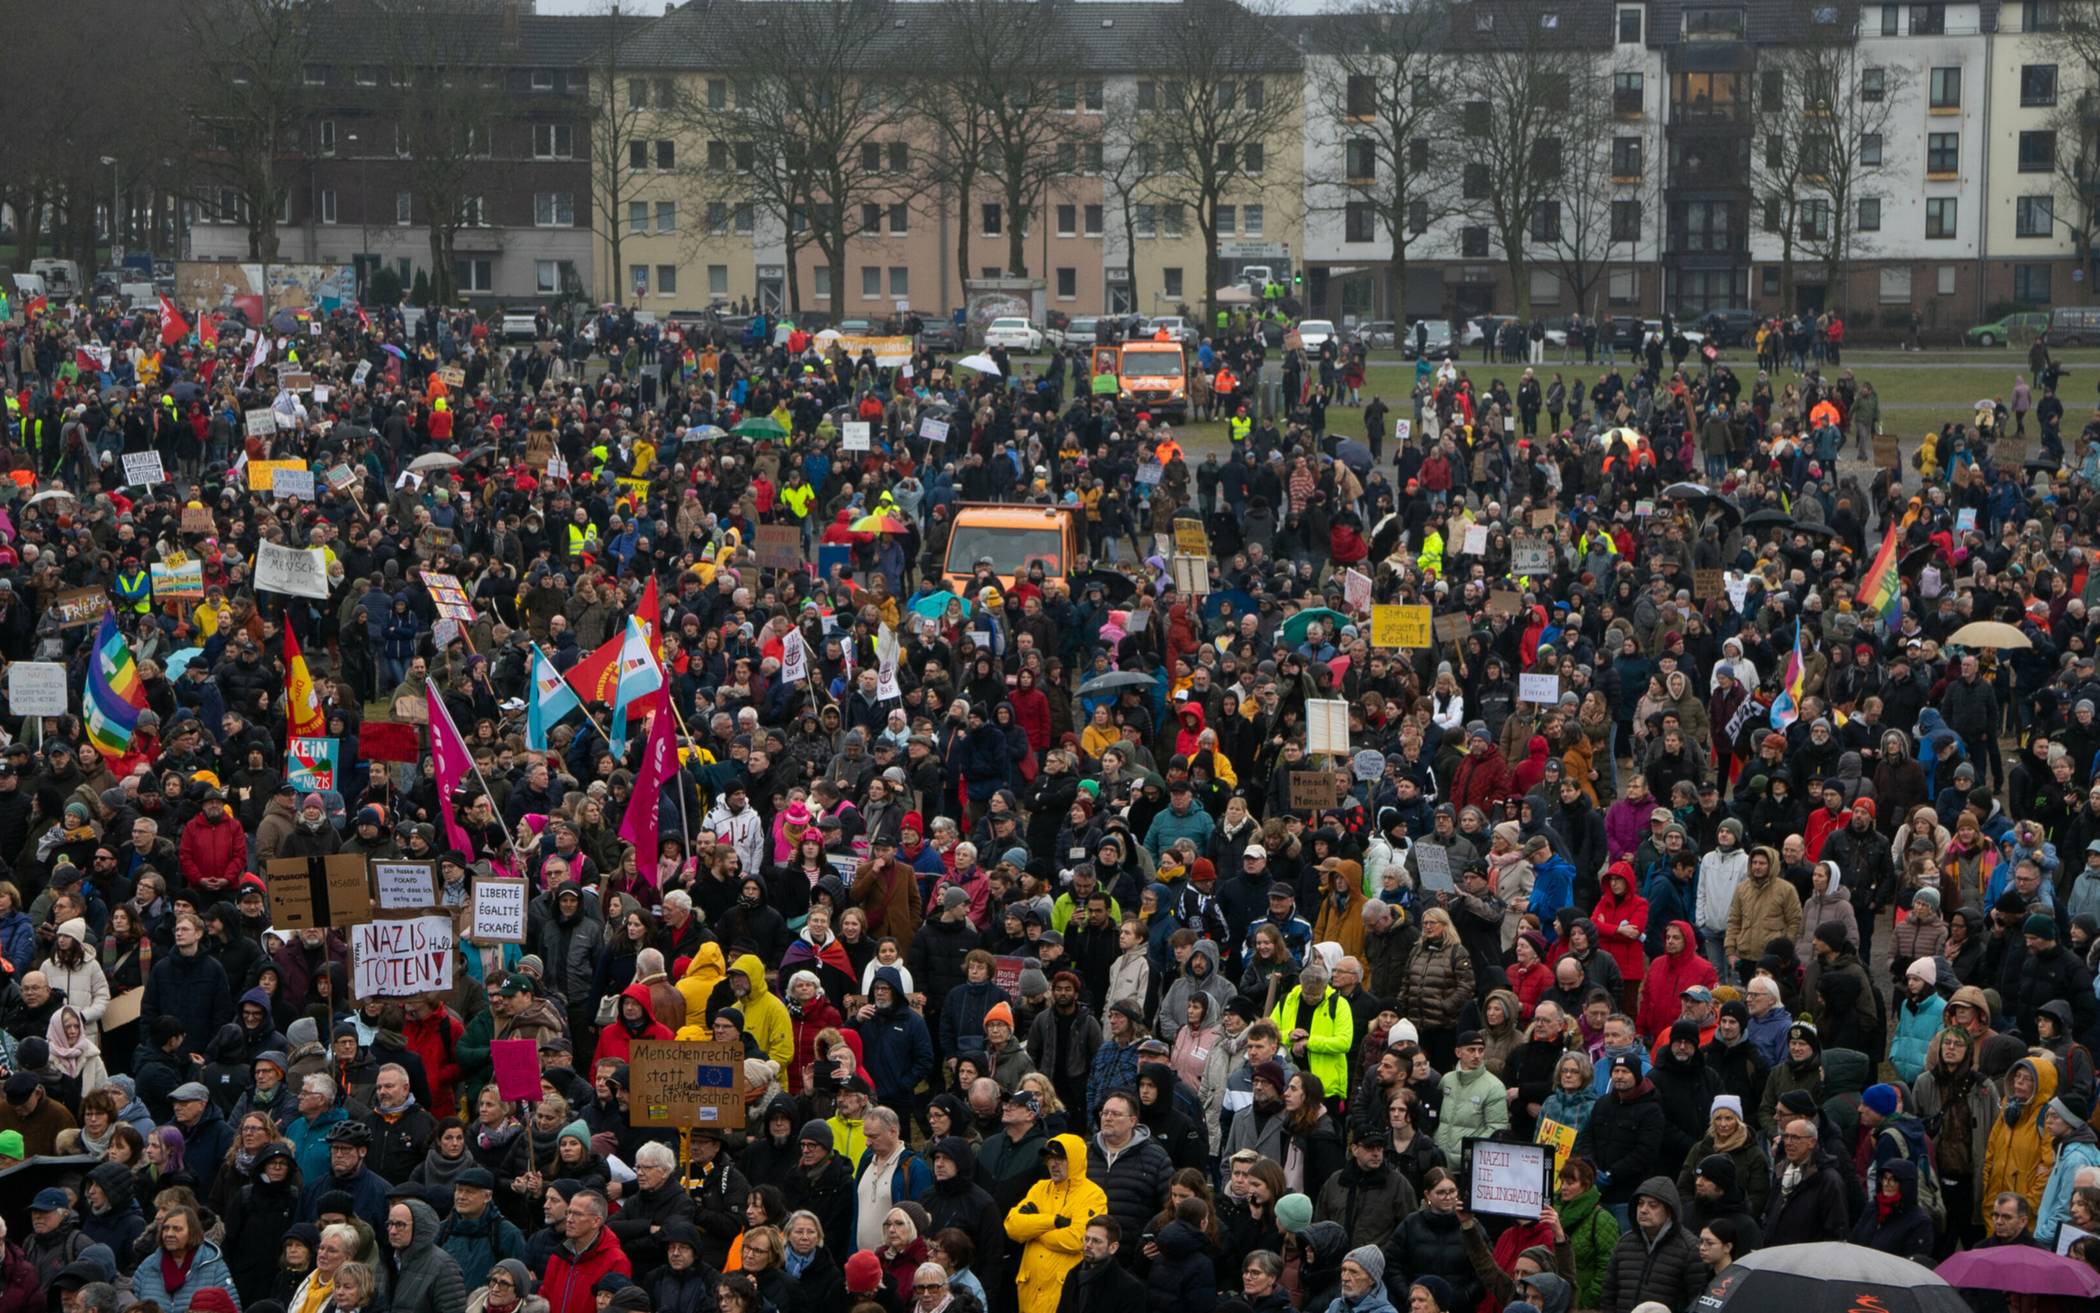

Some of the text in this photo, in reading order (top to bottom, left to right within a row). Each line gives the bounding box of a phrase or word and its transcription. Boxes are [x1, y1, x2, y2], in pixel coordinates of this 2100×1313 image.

[270, 560, 316, 574] MENSCH
[302, 775, 330, 790] NAZIS
[1292, 775, 1330, 787] Mensch
[479, 887, 520, 900] LIBERTÉ
[479, 903, 520, 916] ÉGALITÉ
[363, 922, 426, 955] NAZIS
[633, 1045, 743, 1061] Menschenrechte
[646, 1068, 685, 1083] statt
[680, 1090, 741, 1105] Menschen
